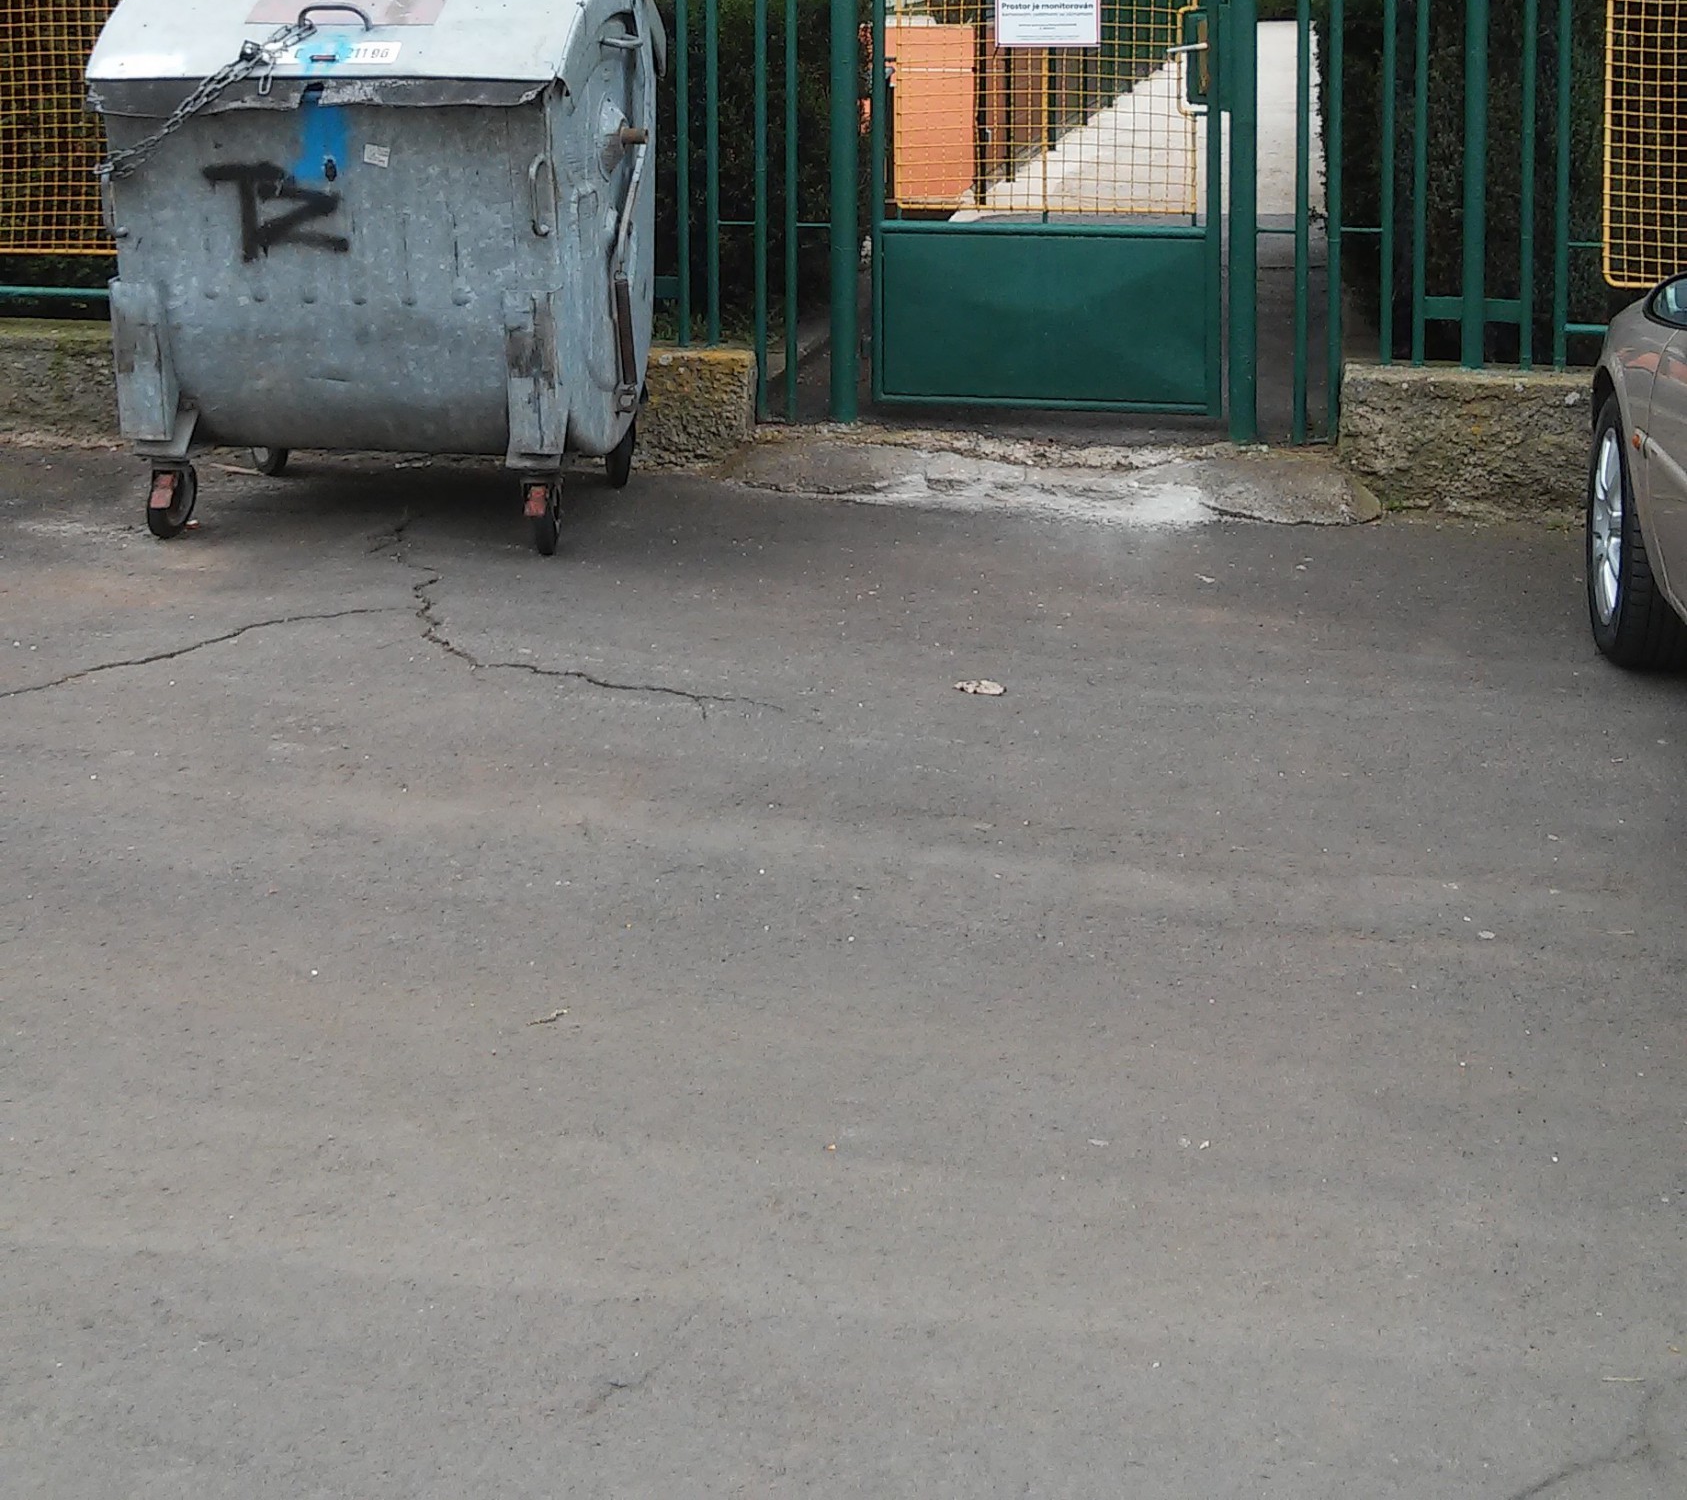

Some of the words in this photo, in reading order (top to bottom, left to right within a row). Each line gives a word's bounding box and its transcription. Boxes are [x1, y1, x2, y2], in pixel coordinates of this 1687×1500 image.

[1001, 2, 1031, 10] Prostor
[1032, 2, 1040, 12] je
[1041, 2, 1094, 10] monitorován
